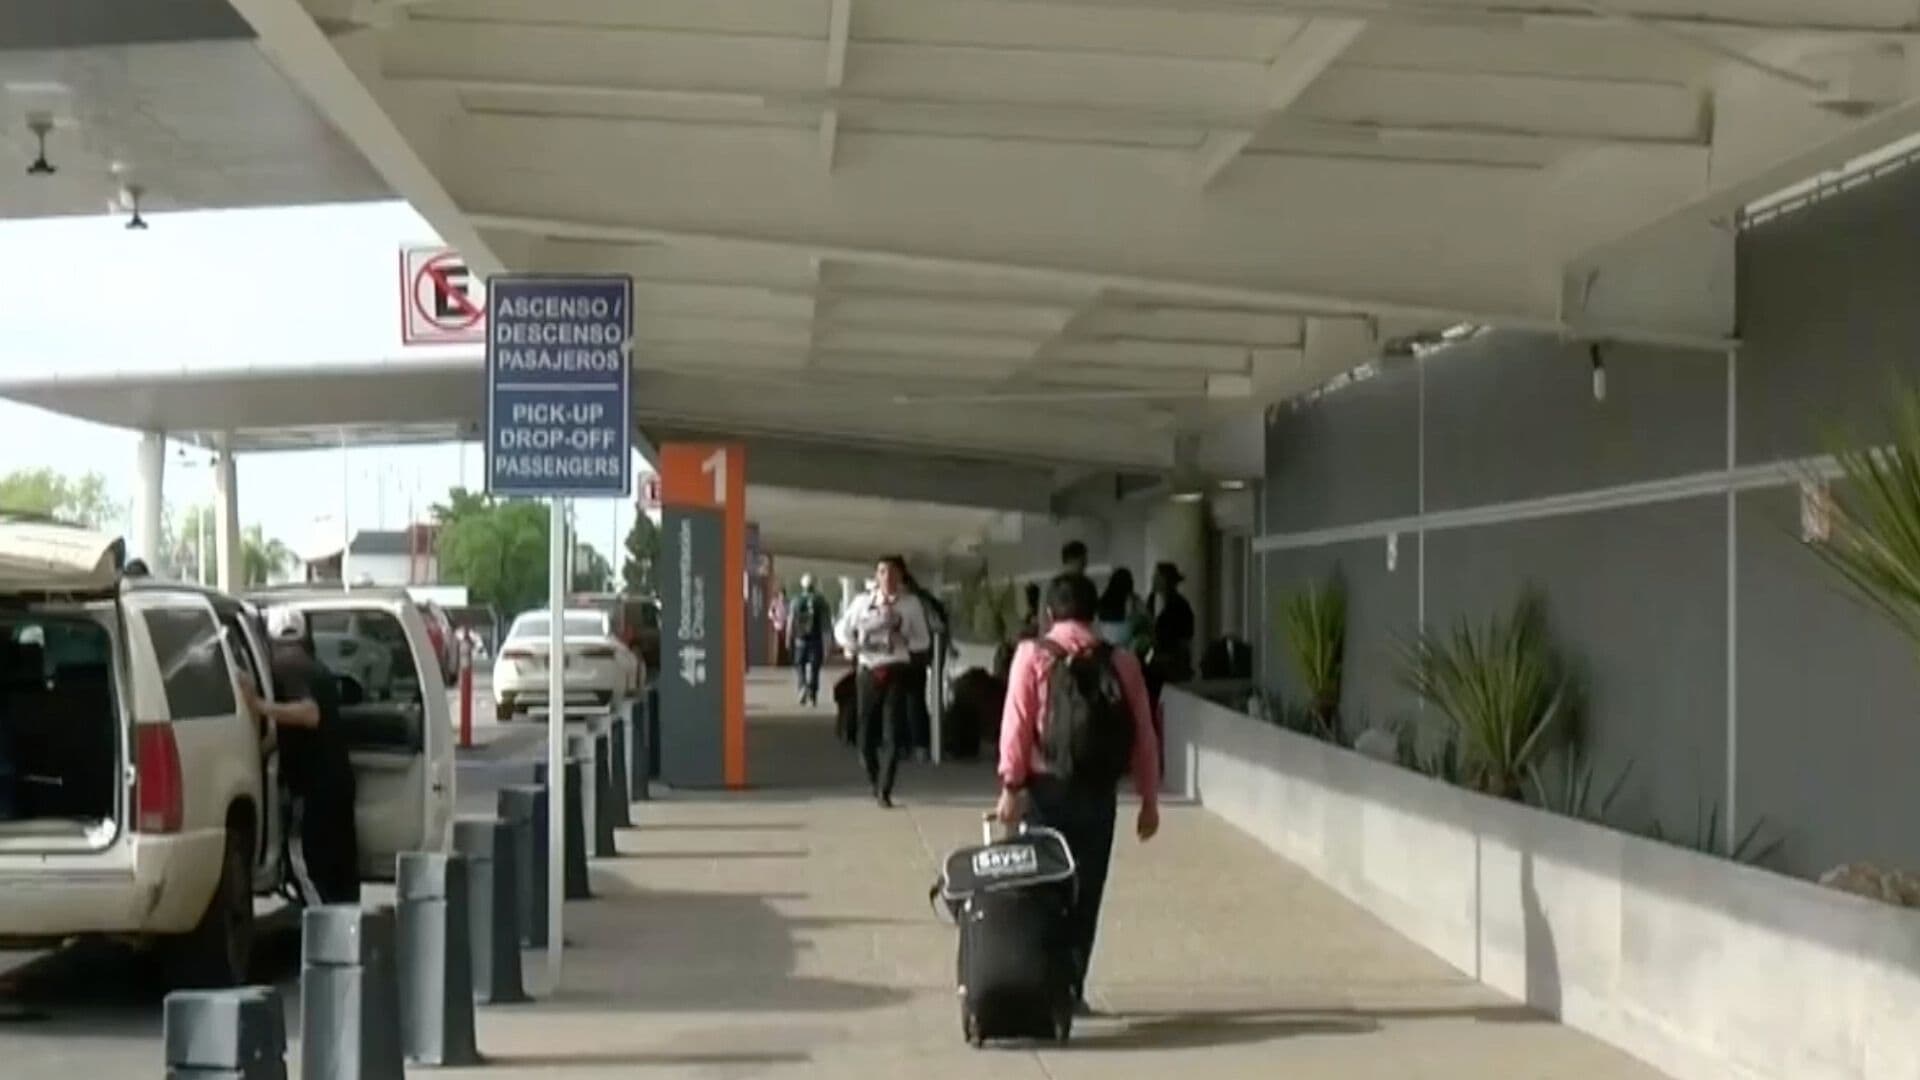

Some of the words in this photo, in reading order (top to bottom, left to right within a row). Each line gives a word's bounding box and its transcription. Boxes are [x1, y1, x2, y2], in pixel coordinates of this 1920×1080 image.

[498, 297, 608, 318] ASCENSO
[613, 298, 621, 318] /
[496, 323, 621, 345] DESCENSO
[498, 349, 620, 371] PASAJEROS
[512, 403, 604, 423] PICK-UP
[500, 428, 616, 449] DROP-OFF
[495, 455, 620, 478] PASSENGERS
[702, 448, 727, 504] 1
